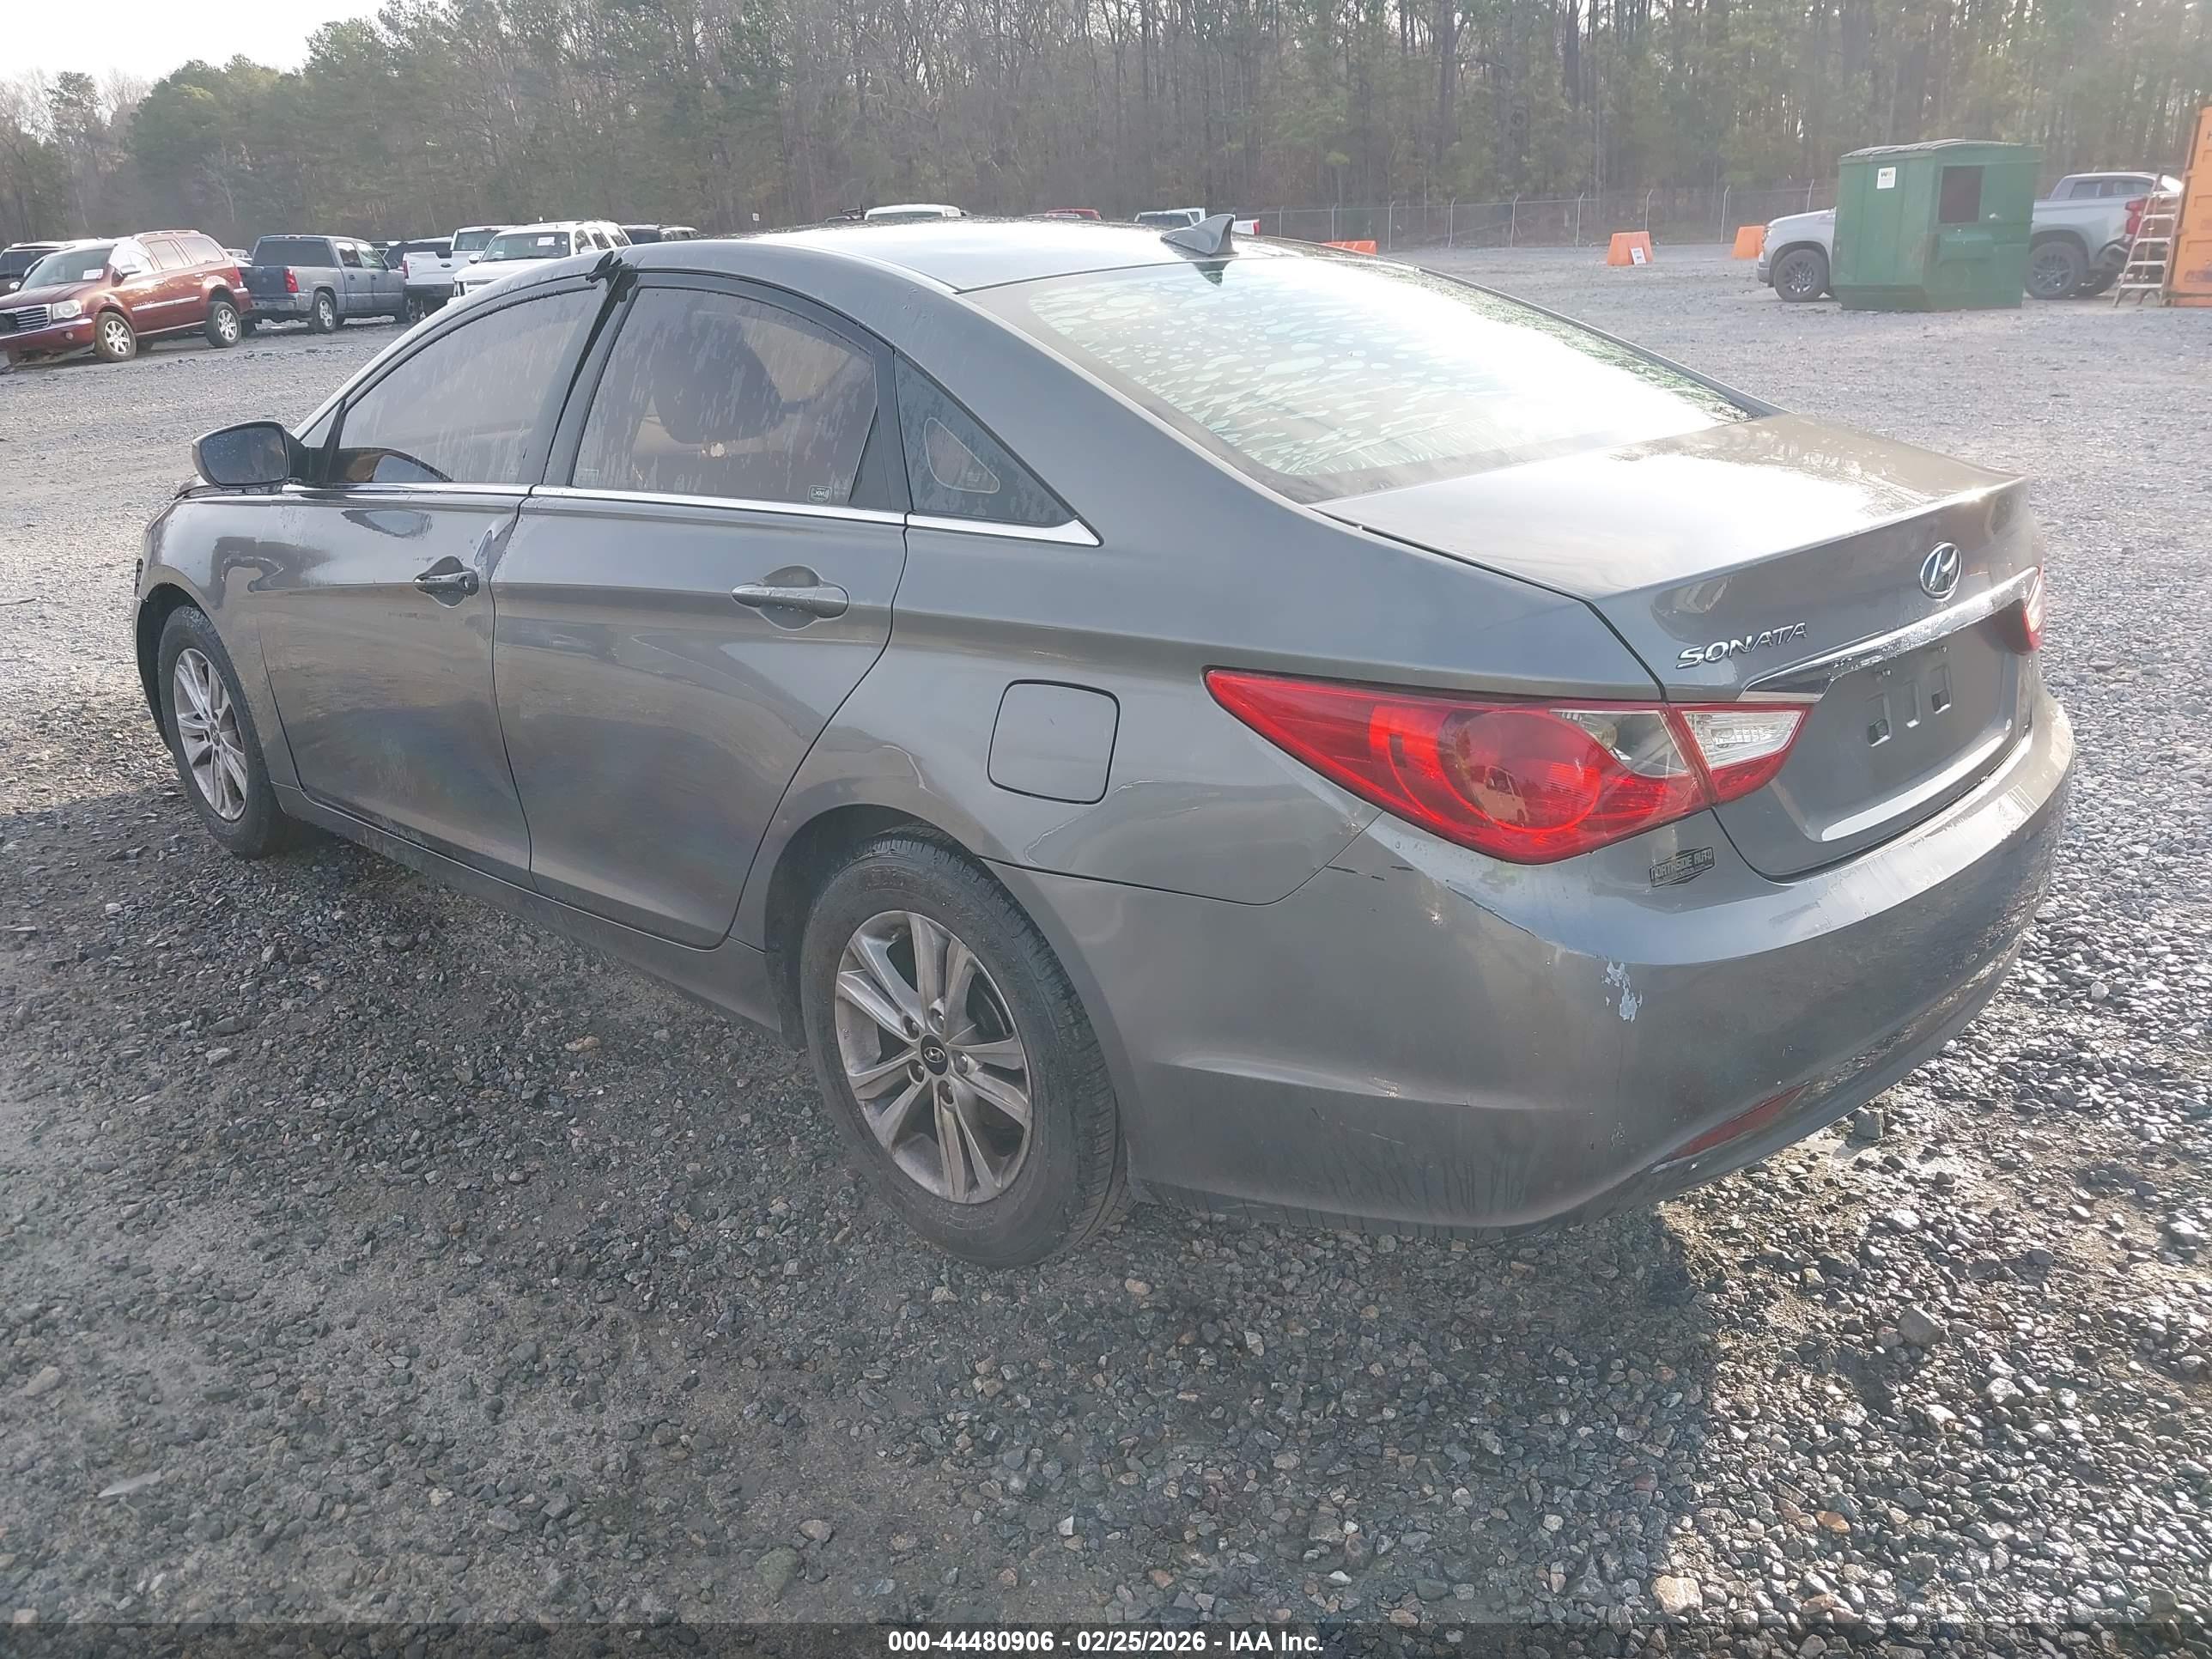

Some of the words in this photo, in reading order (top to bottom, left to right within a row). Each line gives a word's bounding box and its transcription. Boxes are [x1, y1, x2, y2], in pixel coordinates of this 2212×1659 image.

[1676, 623, 1807, 669] SONATA
[1650, 854, 1692, 879] NORTHSIDE
[1693, 848, 1713, 865] AUTO
